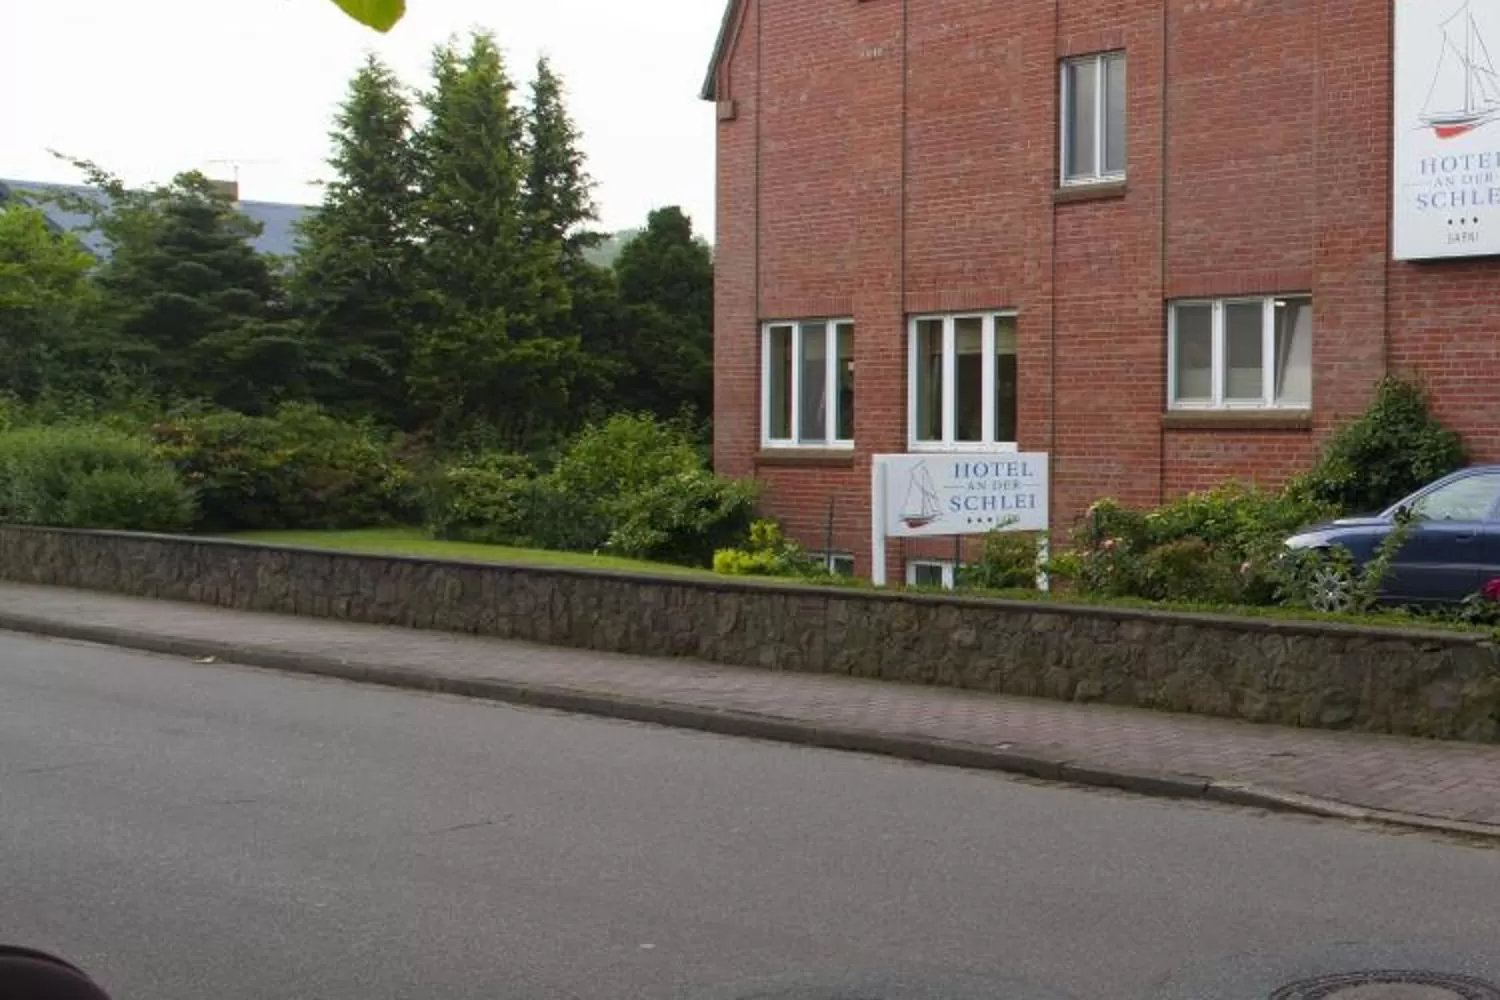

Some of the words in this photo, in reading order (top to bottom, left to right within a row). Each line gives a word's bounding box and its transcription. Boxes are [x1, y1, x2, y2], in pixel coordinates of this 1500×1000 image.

[1433, 175, 1455, 188] AN
[1461, 172, 1494, 185] DER
[953, 461, 1034, 479] HOTEL
[967, 480, 987, 490] AN
[992, 479, 1021, 490] DER
[949, 493, 1036, 512] SCHLEI
